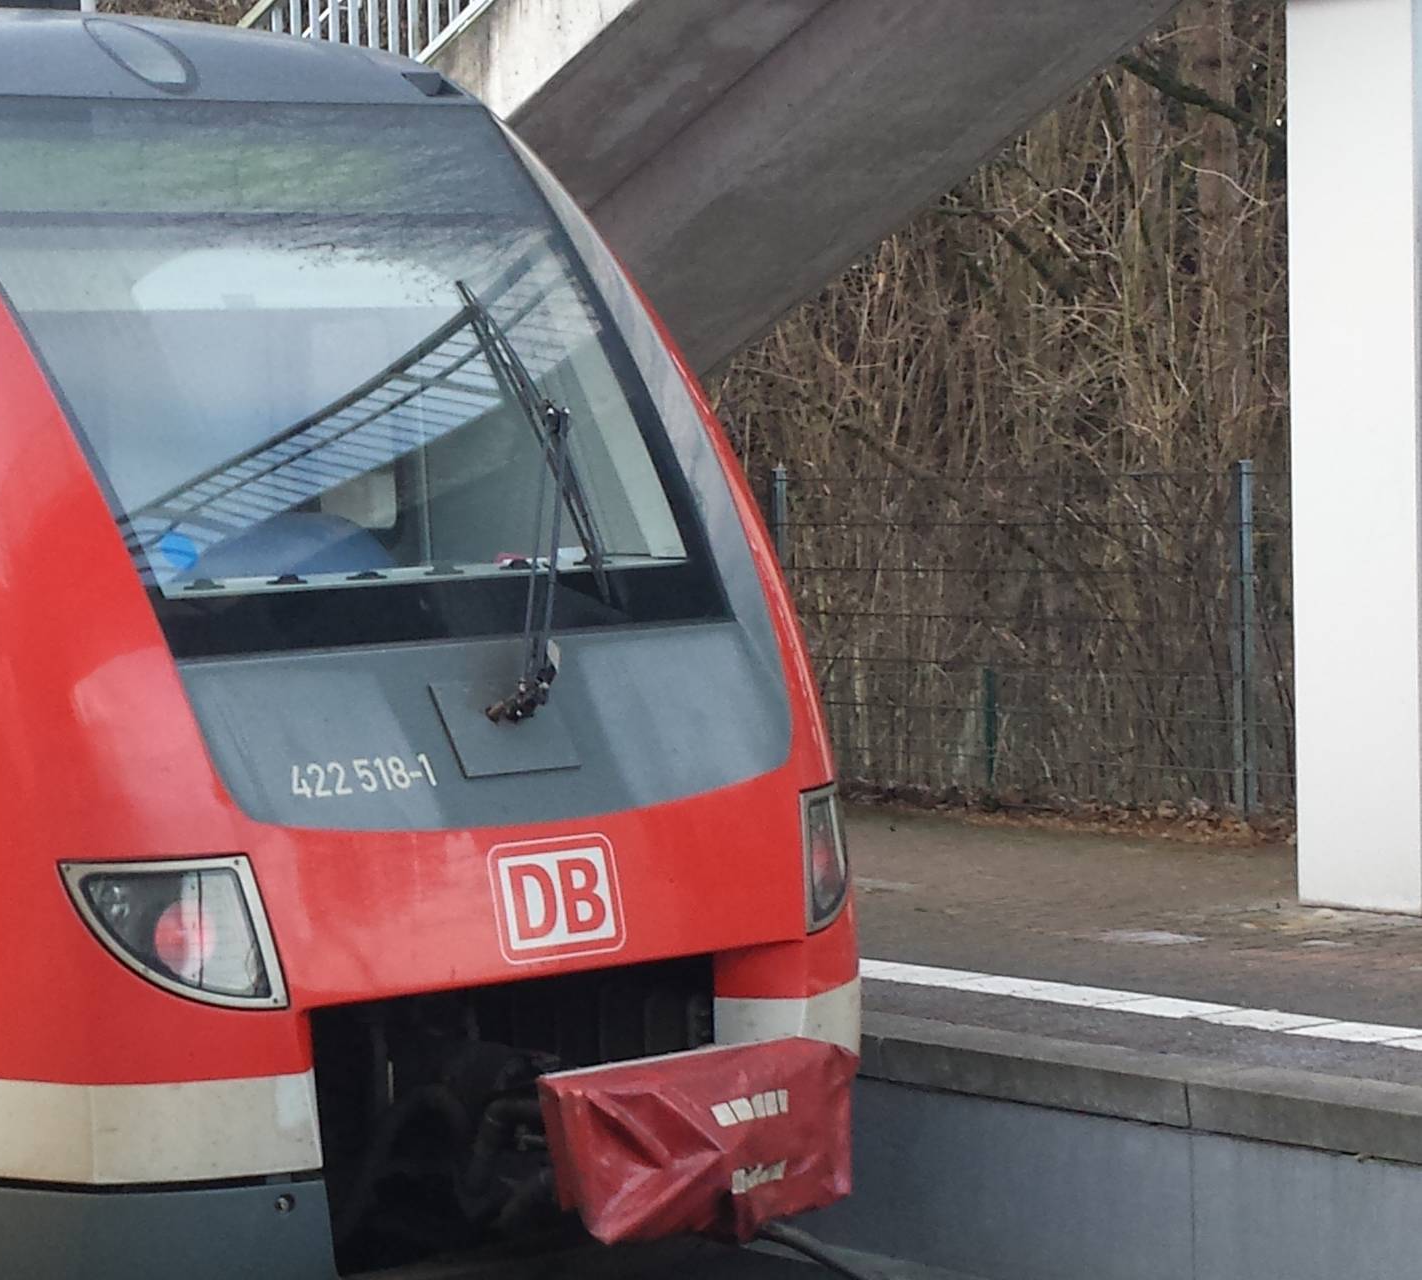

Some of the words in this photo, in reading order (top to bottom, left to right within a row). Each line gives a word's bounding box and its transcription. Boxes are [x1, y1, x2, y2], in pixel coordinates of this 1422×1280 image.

[291, 761, 353, 799] 422
[353, 753, 438, 793] 518-1
[506, 856, 608, 943] DB
